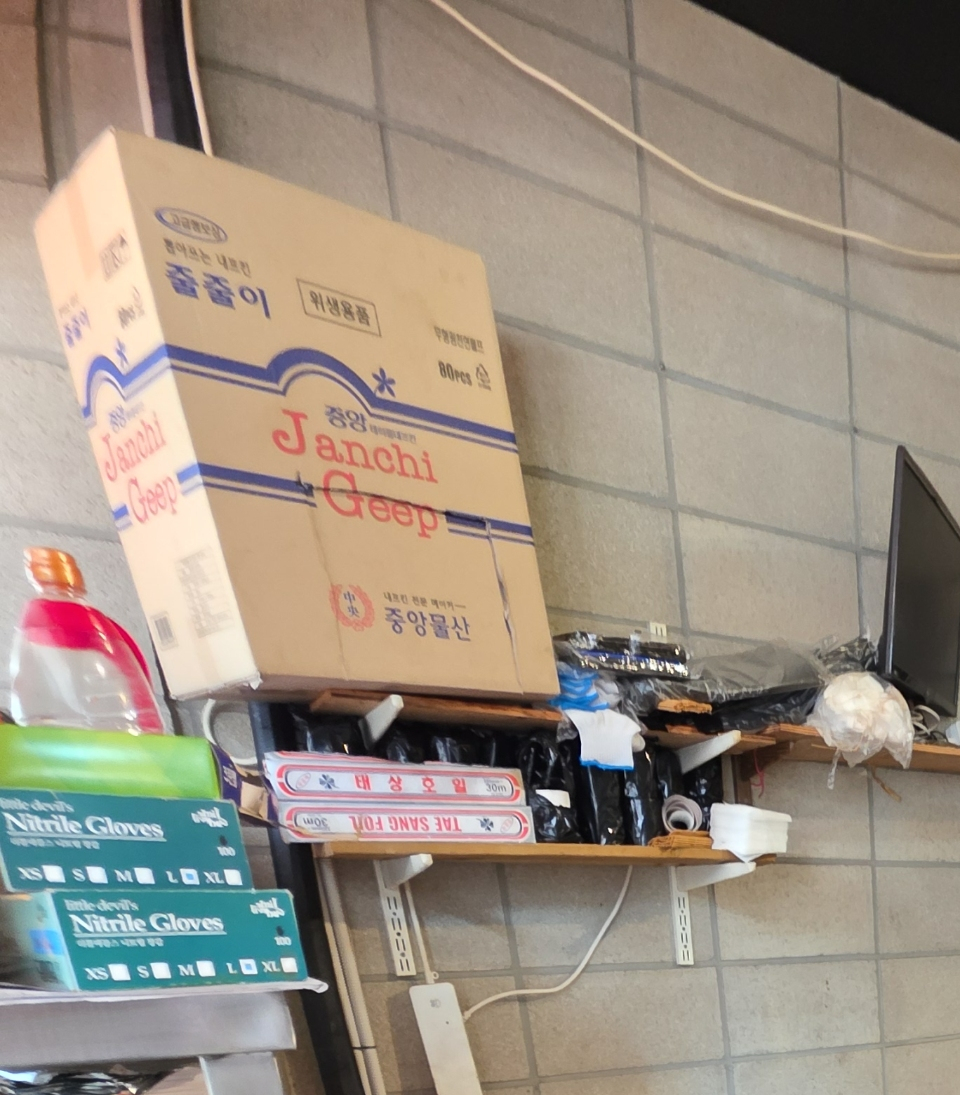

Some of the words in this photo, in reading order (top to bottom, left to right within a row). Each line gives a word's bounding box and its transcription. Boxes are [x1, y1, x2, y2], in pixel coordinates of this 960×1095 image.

[165, 262, 271, 319] 줄줄이
[309, 290, 370, 327] 위생용품
[325, 404, 368, 433] 중앙
[272, 409, 438, 484] Janchi
[322, 469, 438, 539] Geep
[384, 607, 471, 642] 중앙물산
[486, 782, 507, 793] 30m
[2, 811, 82, 834] Nitrile
[85, 815, 164, 837] Gloves
[389, 816, 431, 832] SANG
[435, 816, 462, 832] TAE
[17, 866, 43, 881] XS
[72, 867, 86, 882] S
[114, 869, 134, 883] M
[165, 870, 179, 883] L
[203, 870, 225, 884] XL
[64, 898, 97, 912] little
[98, 898, 139, 912] devil's
[68, 913, 147, 933] Nitrile
[149, 912, 224, 932] Gloves
[274, 936, 292, 946] 100
[83, 967, 109, 981] XS
[136, 965, 150, 979] S
[177, 963, 196, 977] M
[226, 962, 238, 974] L
[261, 960, 280, 973] XL
